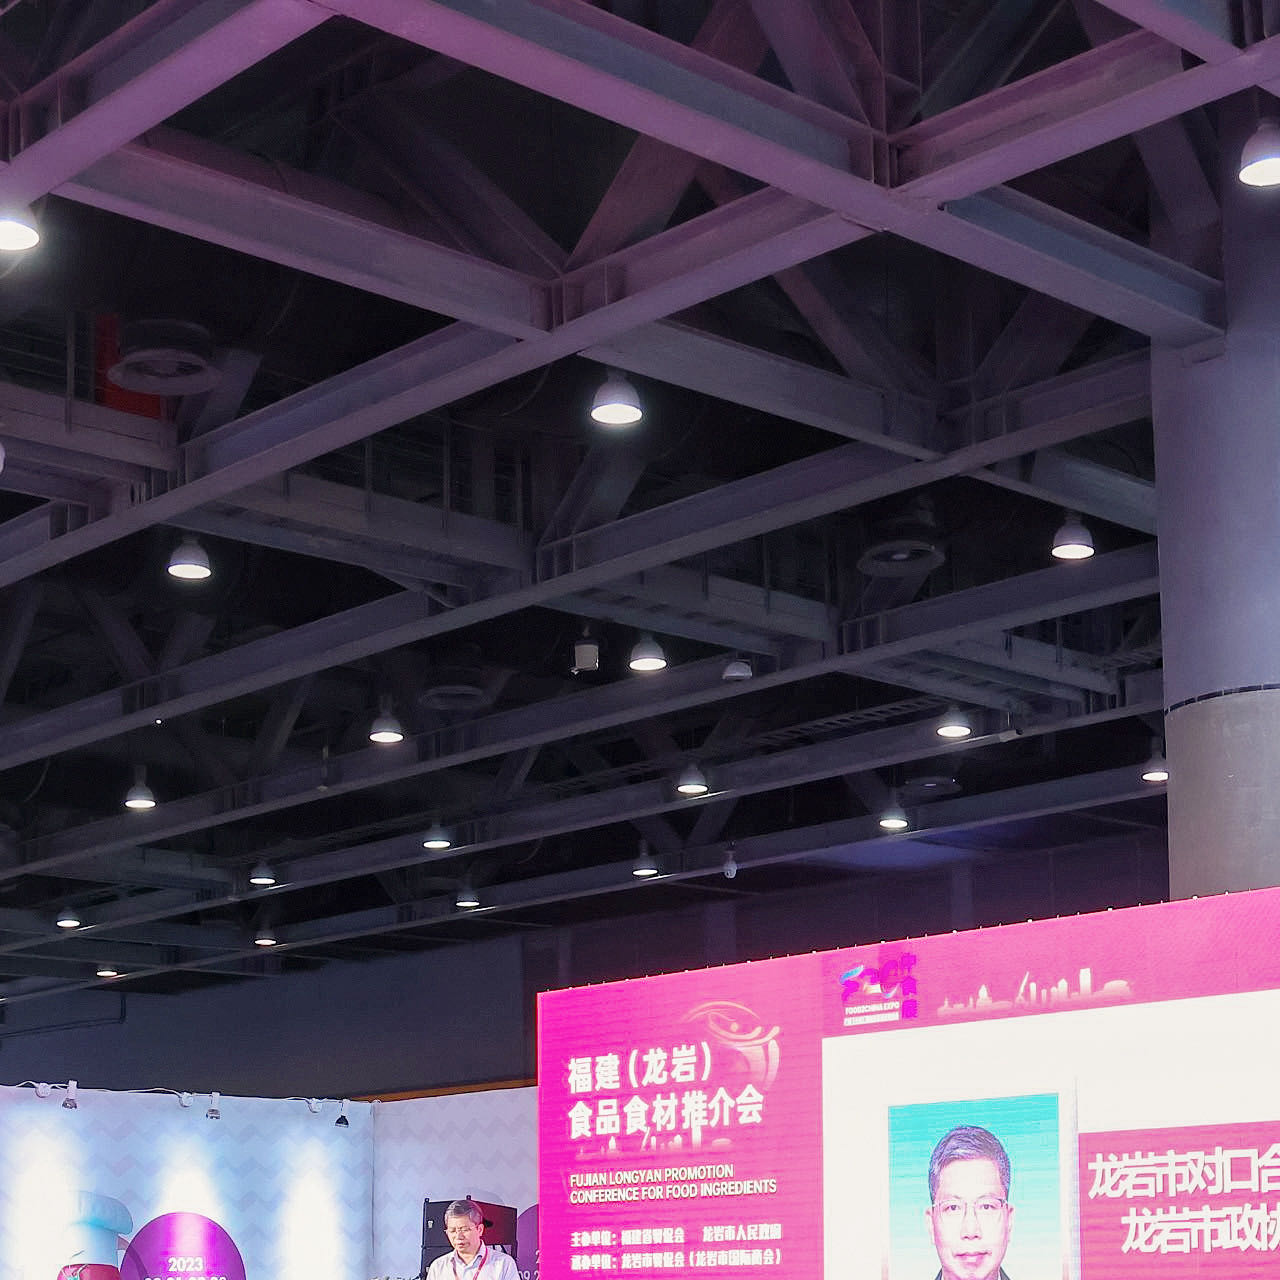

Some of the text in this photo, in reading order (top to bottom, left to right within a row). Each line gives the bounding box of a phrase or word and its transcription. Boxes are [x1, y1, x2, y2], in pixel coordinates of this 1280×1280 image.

[568, 1042, 711, 1094] 福建（龙岩）
[568, 1084, 764, 1139] 食品食材推介会
[570, 1164, 734, 1188] FUJIAN LONGYAN PROMOTION
[570, 1179, 777, 1204] CONFERENCE FOR FOOD INGREDIENTS
[168, 1256, 203, 1272] 2023
